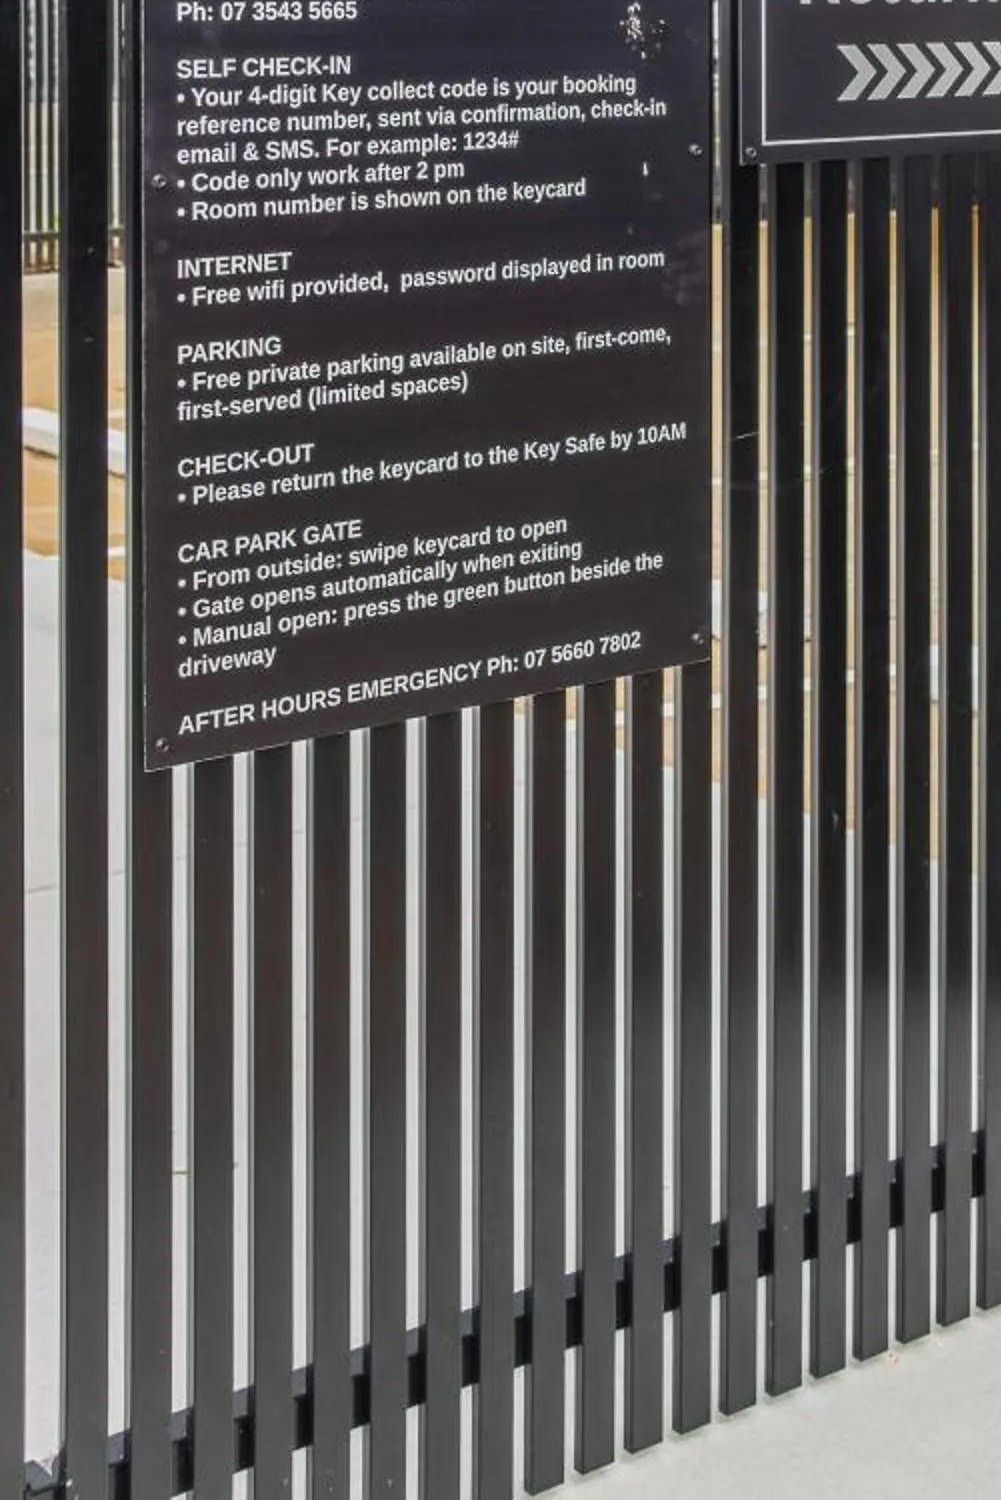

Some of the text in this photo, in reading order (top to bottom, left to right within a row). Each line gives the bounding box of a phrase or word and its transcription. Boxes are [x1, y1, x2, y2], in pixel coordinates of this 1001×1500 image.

[175, 0, 358, 22] Ph: 07 3543 5665
[175, 55, 351, 79] SELF CHECK-IN
[190, 73, 637, 109] Your 4-digit Key collect code is your booking
[176, 97, 667, 136] reference number, sent via confirmation, check-in
[175, 129, 519, 165] email & SMS. For example: 1234#
[190, 160, 465, 192] Code only work after 2 pm
[191, 176, 586, 220] Room number is shown on the keycard
[176, 251, 293, 279] INTERNET
[191, 251, 665, 306] Free wifi provided, password displayed in room
[176, 335, 281, 364] PARKING
[191, 326, 671, 391] Free private parking available on site, first-come,
[175, 369, 468, 421] first-served (limited spaces)
[176, 442, 315, 478] CHECK-OUT
[192, 421, 686, 505] Please return the keycard to the Key Safe by 10AM
[176, 518, 362, 563] CAR PARK GATE
[192, 518, 567, 591] From outside: swipe keycard to open
[192, 540, 583, 618] Gate opens automatically when exiting
[192, 552, 663, 647] Manual open: press the green button beside the
[177, 646, 277, 678] driveway
[177, 630, 641, 735] AFTER HOURS EMERGENCY Ph: 07 5660 7802
